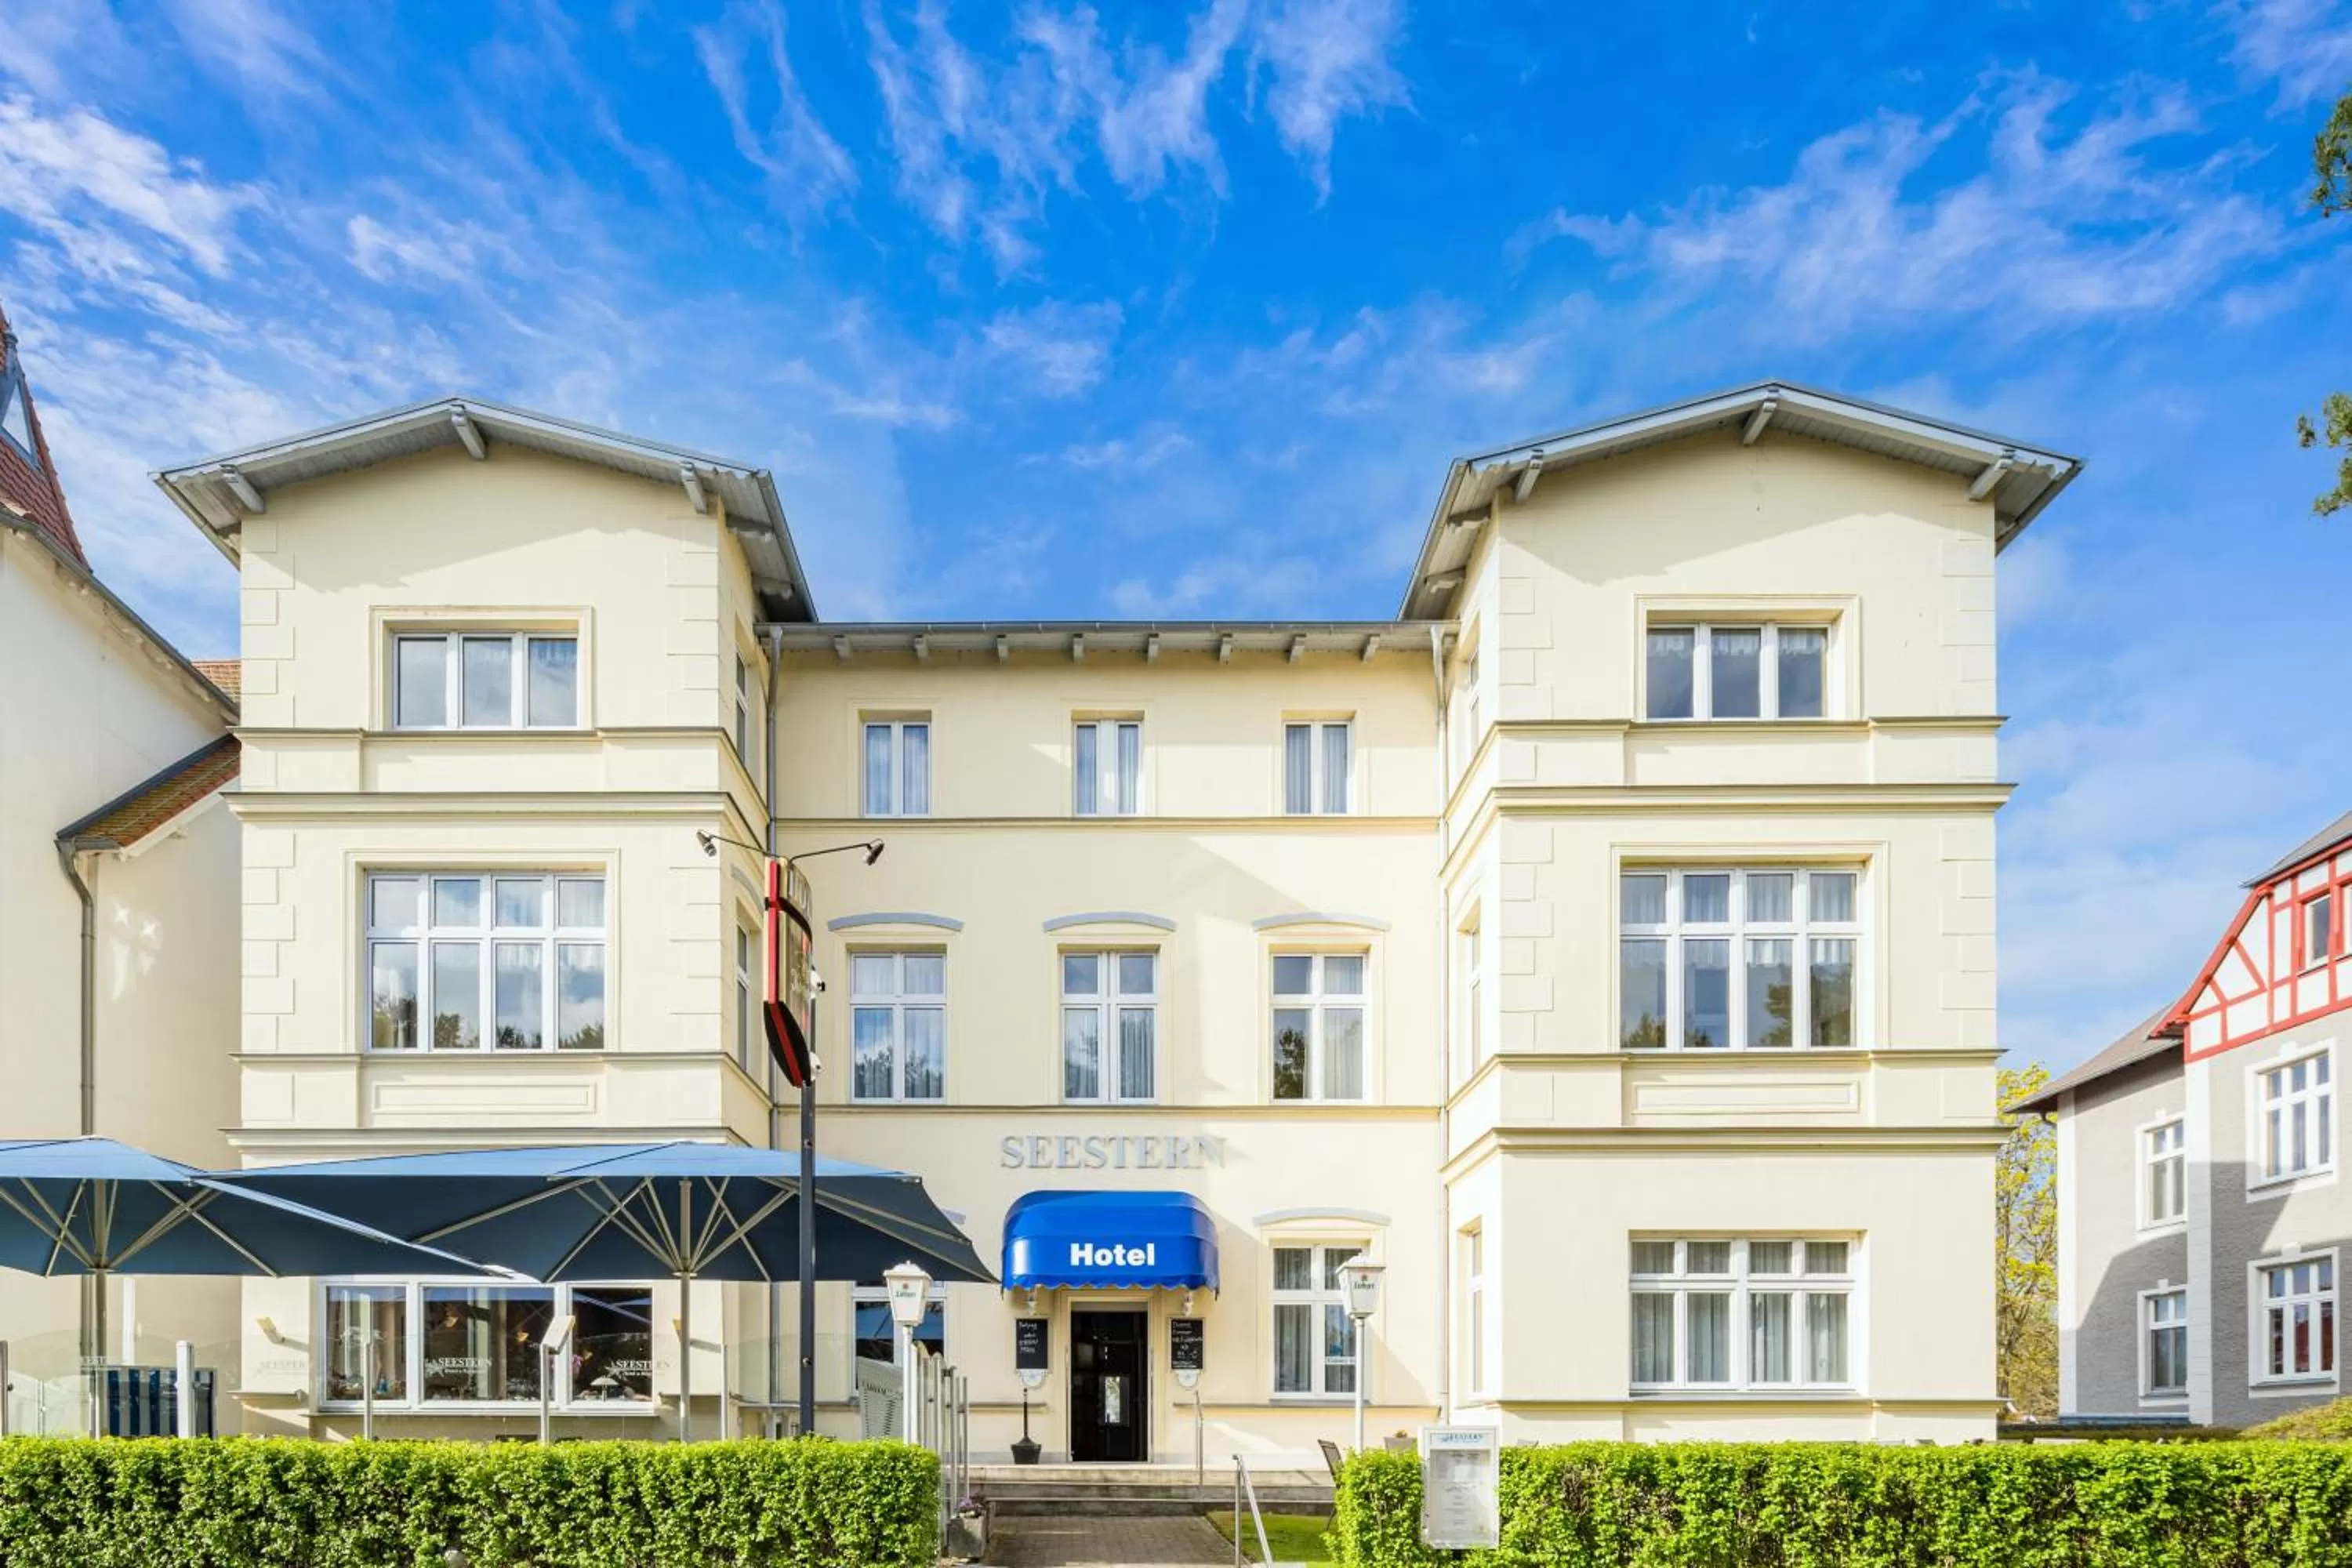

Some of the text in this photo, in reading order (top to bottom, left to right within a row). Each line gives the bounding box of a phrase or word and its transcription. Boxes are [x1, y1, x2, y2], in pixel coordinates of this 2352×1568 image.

[1000, 1135, 1227, 1170] SEESTERN
[1070, 1243, 1155, 1266] Hotel
[439, 1357, 493, 1367] SEESTERN
